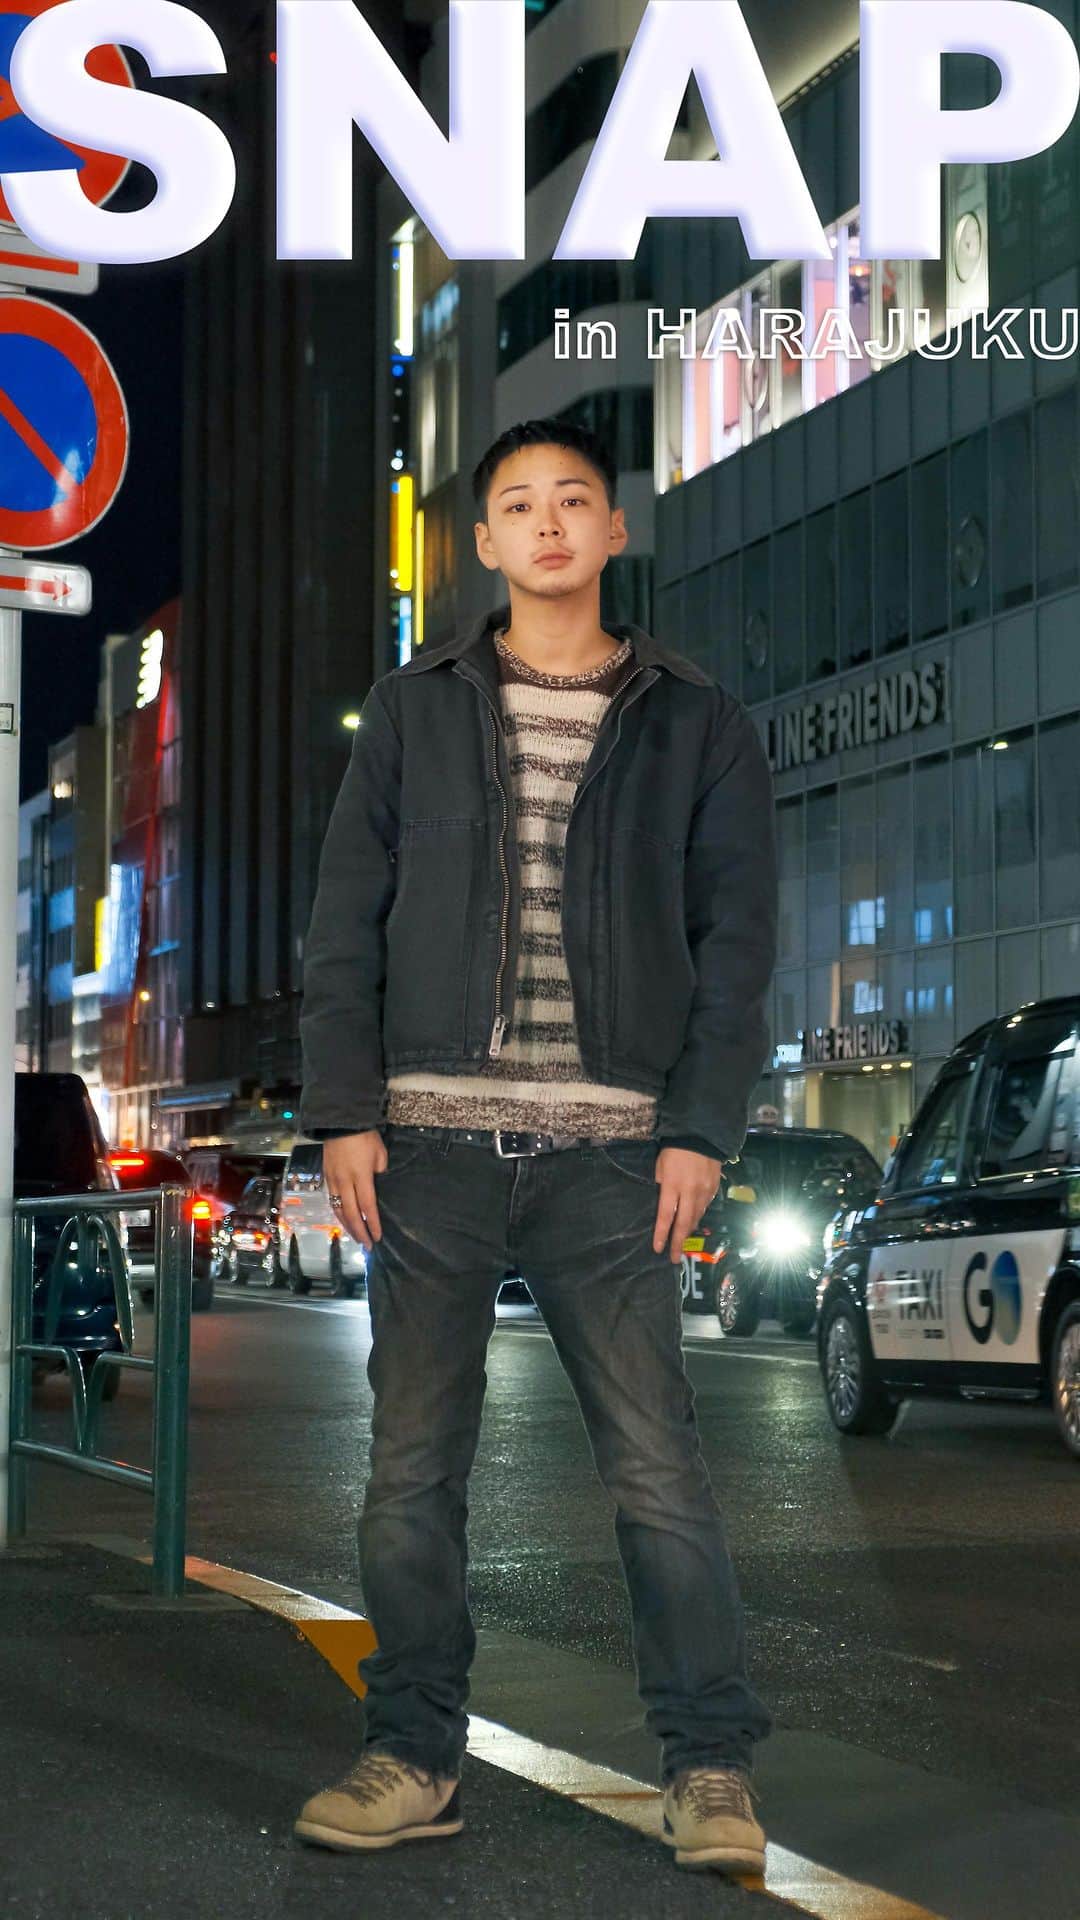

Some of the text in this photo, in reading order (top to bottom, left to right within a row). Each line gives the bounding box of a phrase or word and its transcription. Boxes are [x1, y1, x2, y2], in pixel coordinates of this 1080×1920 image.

[762, 661, 939, 772] LINE FRIENDS
[834, 1020, 901, 1061] FRIENDS
[896, 1268, 943, 1321] TAXI
[963, 1250, 1022, 1345] GO
